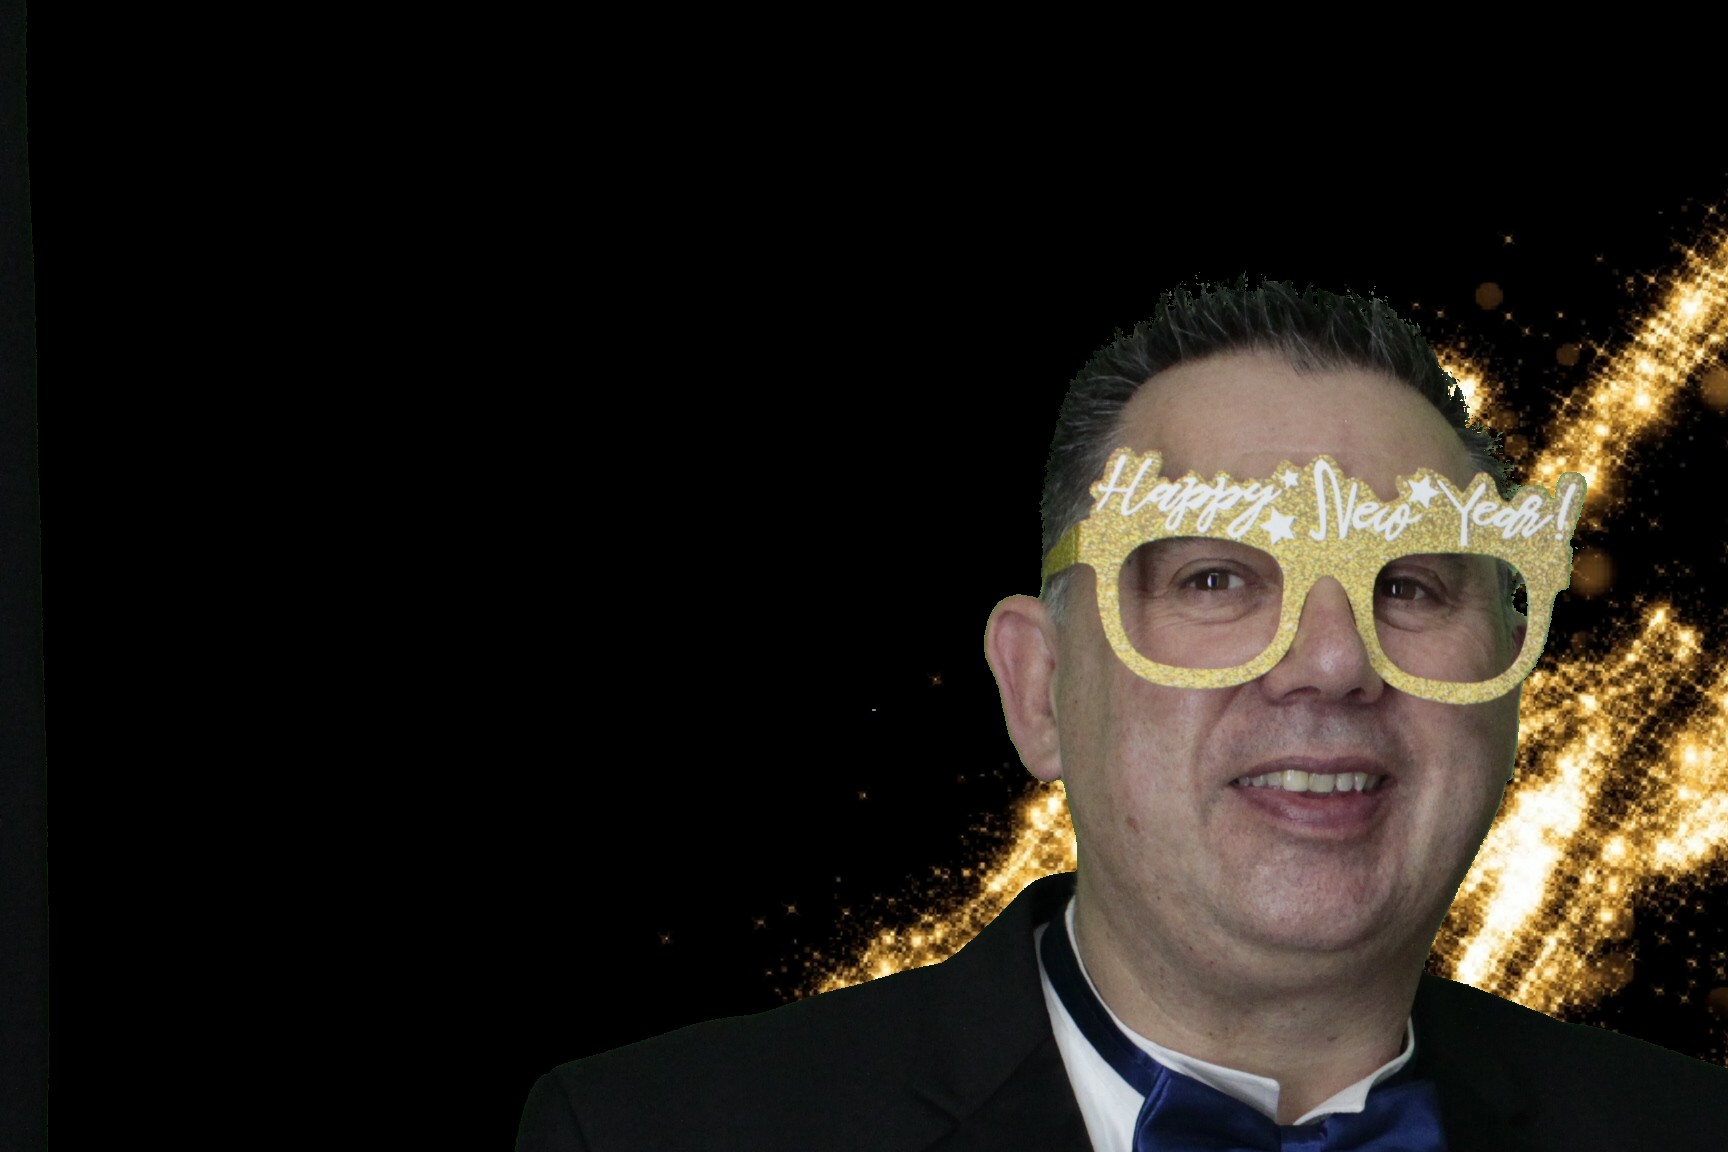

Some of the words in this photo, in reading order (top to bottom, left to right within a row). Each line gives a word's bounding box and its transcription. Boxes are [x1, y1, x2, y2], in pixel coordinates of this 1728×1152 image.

[1097, 455, 1283, 533] Happy
[1309, 459, 1424, 543] New
[1438, 479, 1578, 546] Year!
